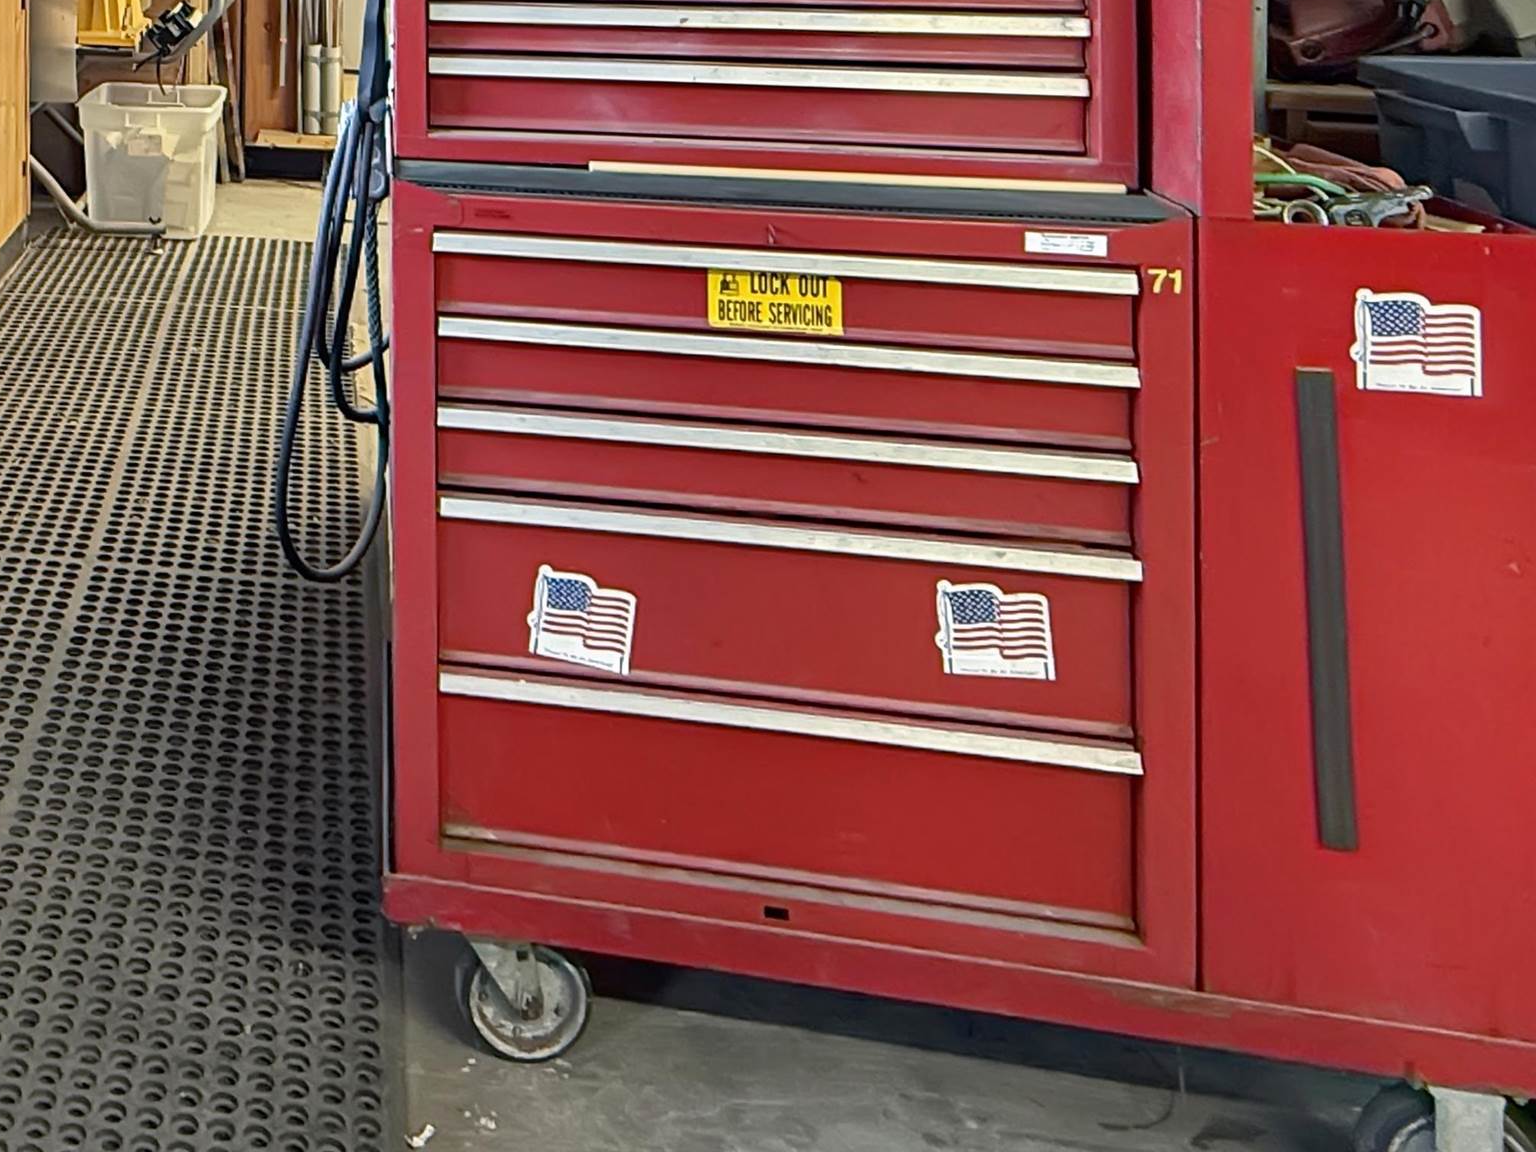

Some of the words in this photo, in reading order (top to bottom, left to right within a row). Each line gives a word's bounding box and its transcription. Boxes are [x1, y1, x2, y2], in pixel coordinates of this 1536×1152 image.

[750, 272, 790, 296] LOCK
[799, 275, 828, 298] OUT
[1147, 269, 1182, 294] 71
[718, 299, 763, 323] BEFORE
[769, 302, 832, 327] SERVICING
